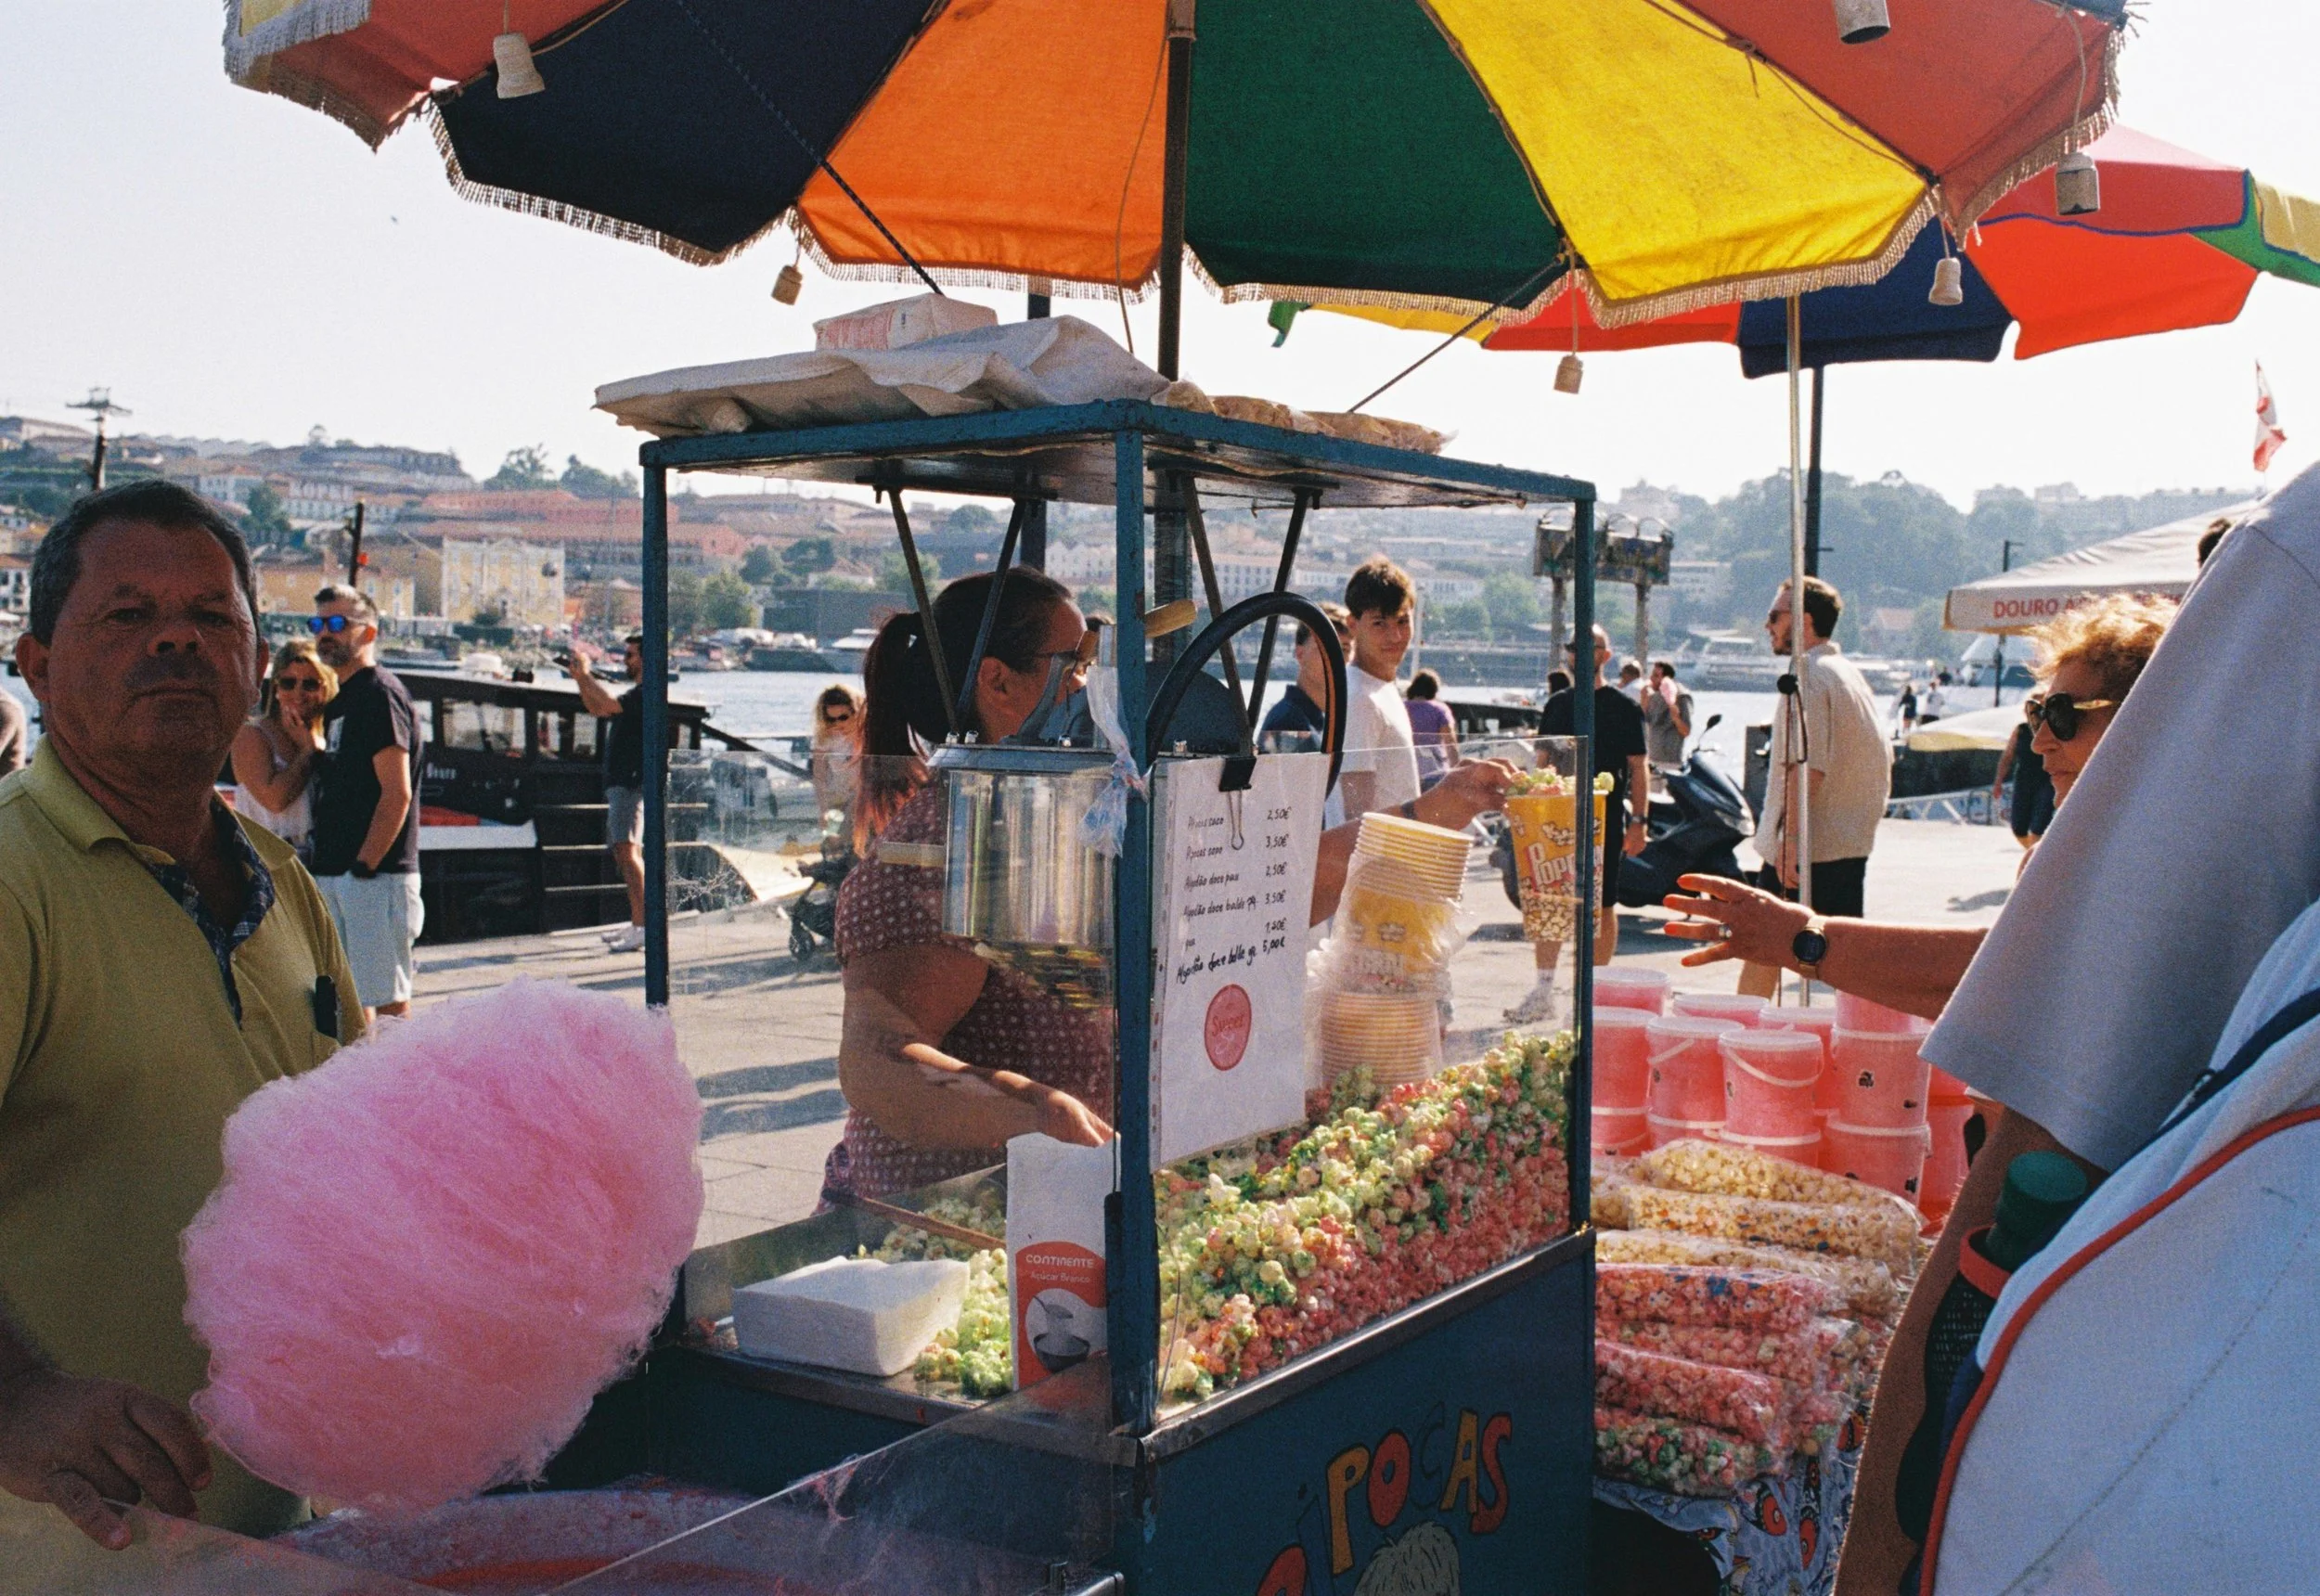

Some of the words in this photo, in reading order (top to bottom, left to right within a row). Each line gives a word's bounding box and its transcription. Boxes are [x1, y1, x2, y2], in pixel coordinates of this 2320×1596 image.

[1994, 598, 2058, 617] DOURO
[1208, 872, 1224, 885] doce
[1207, 900, 1223, 914] doce
[1025, 1254, 1094, 1268] CONTINENTE
[1060, 1271, 1091, 1283] Branco
